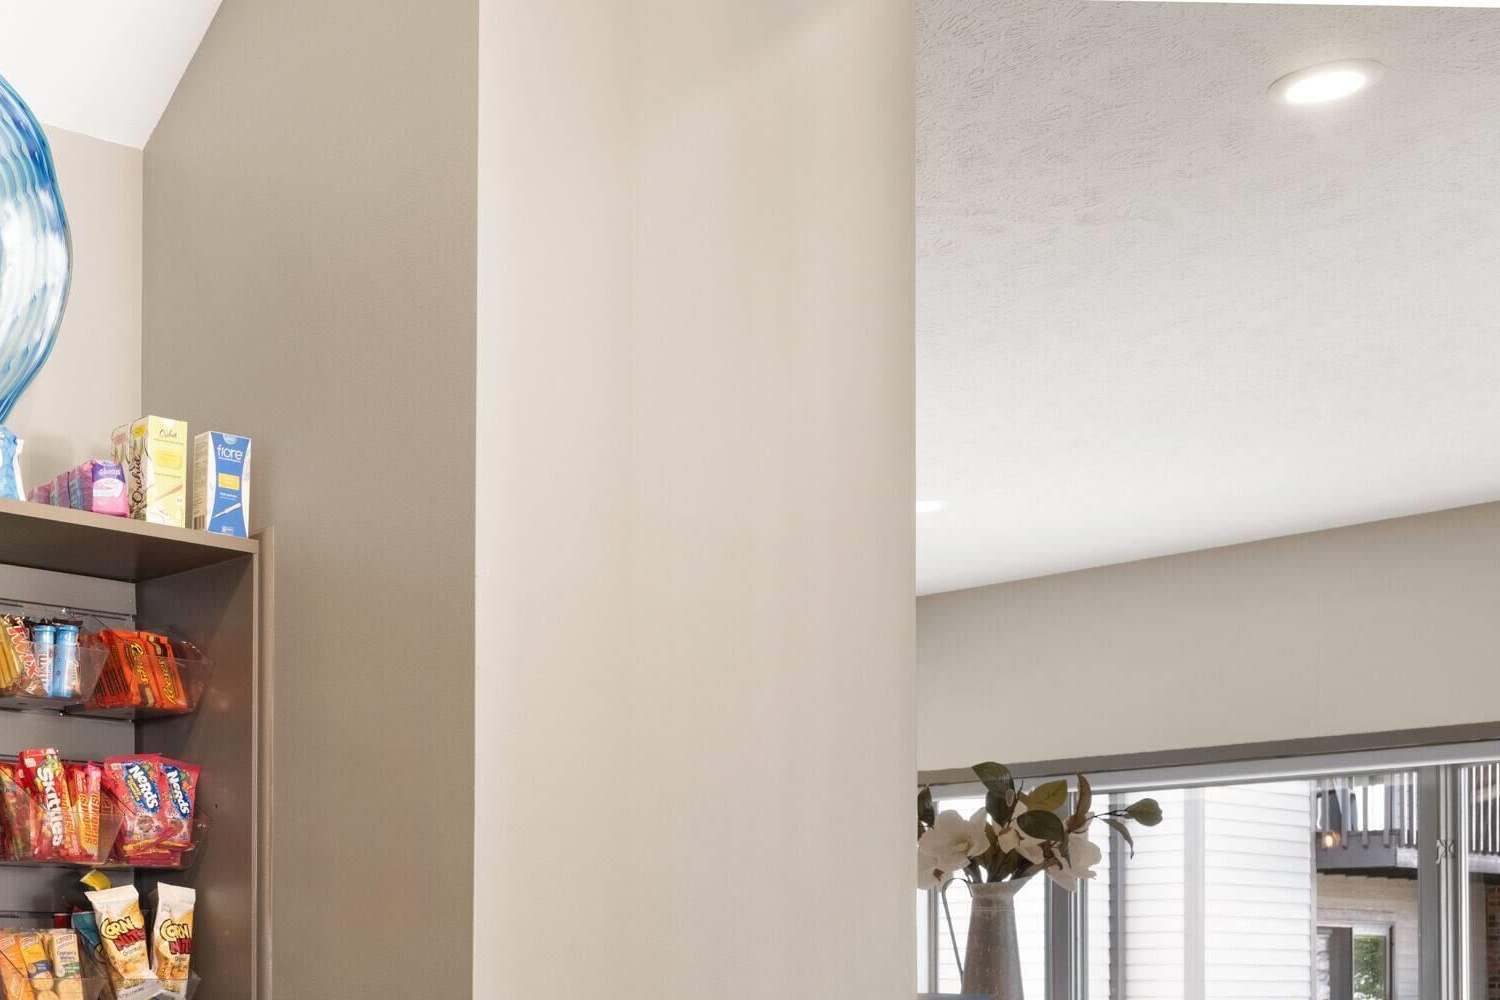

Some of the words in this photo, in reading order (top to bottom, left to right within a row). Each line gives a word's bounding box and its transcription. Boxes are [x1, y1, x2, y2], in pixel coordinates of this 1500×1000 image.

[216, 444, 243, 461] fiore
[99, 468, 120, 477] always
[128, 765, 159, 809] Nerds
[167, 770, 190, 814] Nerds
[37, 767, 64, 847] Skittles
[100, 916, 136, 941] CORN
